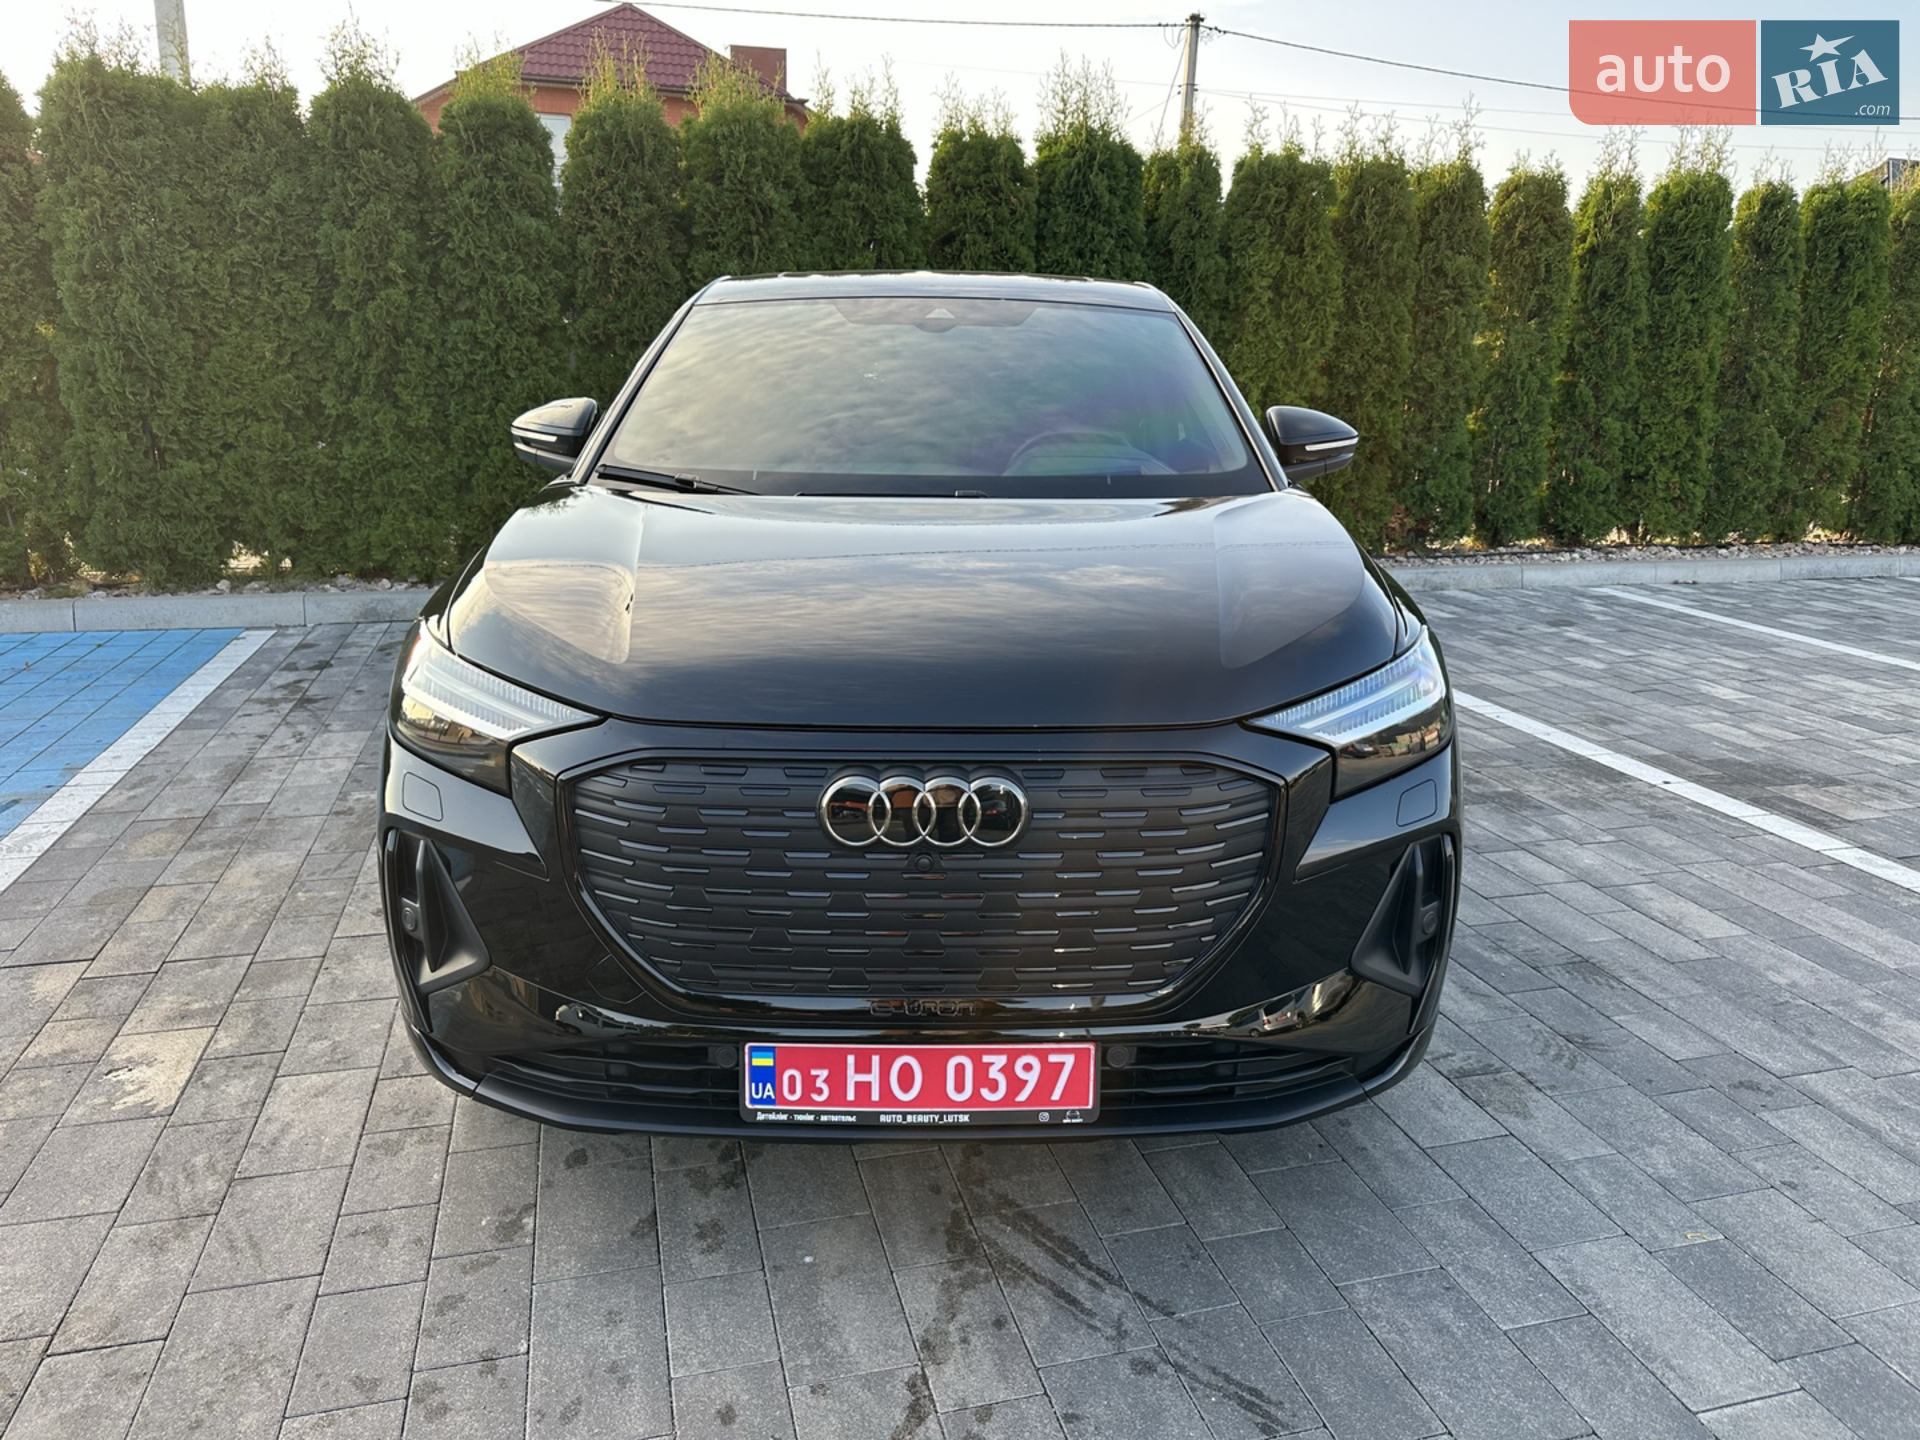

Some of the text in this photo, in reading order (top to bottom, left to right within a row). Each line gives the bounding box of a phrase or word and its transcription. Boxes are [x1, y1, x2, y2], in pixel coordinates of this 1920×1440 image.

[751, 1082, 775, 1100] UA
[782, 1068, 830, 1103] 03
[945, 1053, 1077, 1103] 0397
